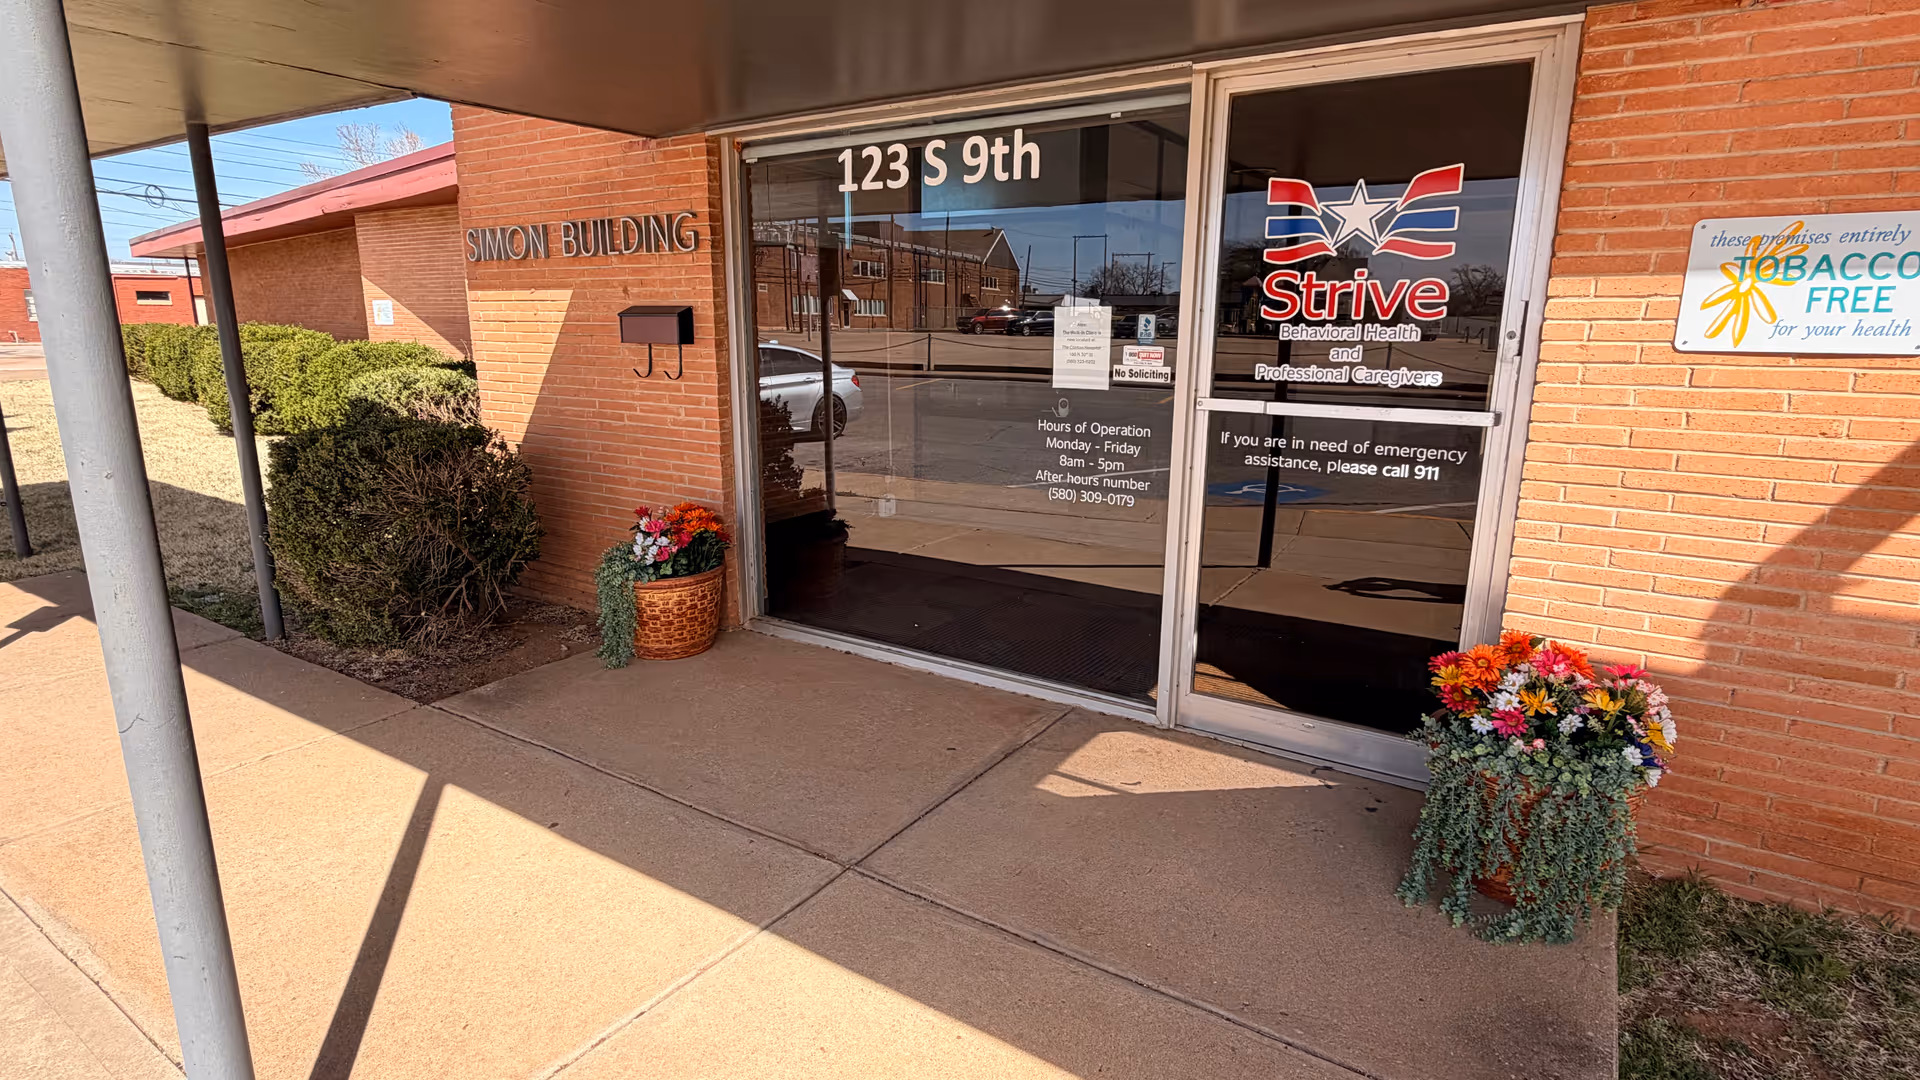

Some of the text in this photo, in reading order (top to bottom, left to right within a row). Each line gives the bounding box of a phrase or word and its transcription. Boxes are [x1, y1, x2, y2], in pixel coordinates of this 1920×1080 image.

[837, 128, 1040, 192] 123 S 9th
[467, 211, 699, 262] SIMON BUILDING
[1710, 224, 1912, 250] these premises entirely
[1734, 251, 1920, 282] TOBACCO
[1260, 268, 1450, 321] Strive
[1805, 285, 1896, 314] FREE
[1279, 323, 1421, 342] Behavioral Health
[1768, 319, 1912, 340] for your health
[1329, 345, 1363, 362] and
[1114, 368, 1169, 382] No Soliciting
[1255, 364, 1443, 387] Professional Caregivers
[1038, 419, 1151, 438] Hours of Operation
[1046, 437, 1092, 453] Monday
[1104, 441, 1141, 457] Friday
[1221, 431, 1467, 465] If you are in need of emergency
[1059, 455, 1085, 468] 8am
[1097, 458, 1125, 472] 5pm
[1244, 453, 1440, 481] assistance, please call 911
[1035, 470, 1151, 491] After hours number
[1048, 487, 1135, 507] (580) 309-0179
